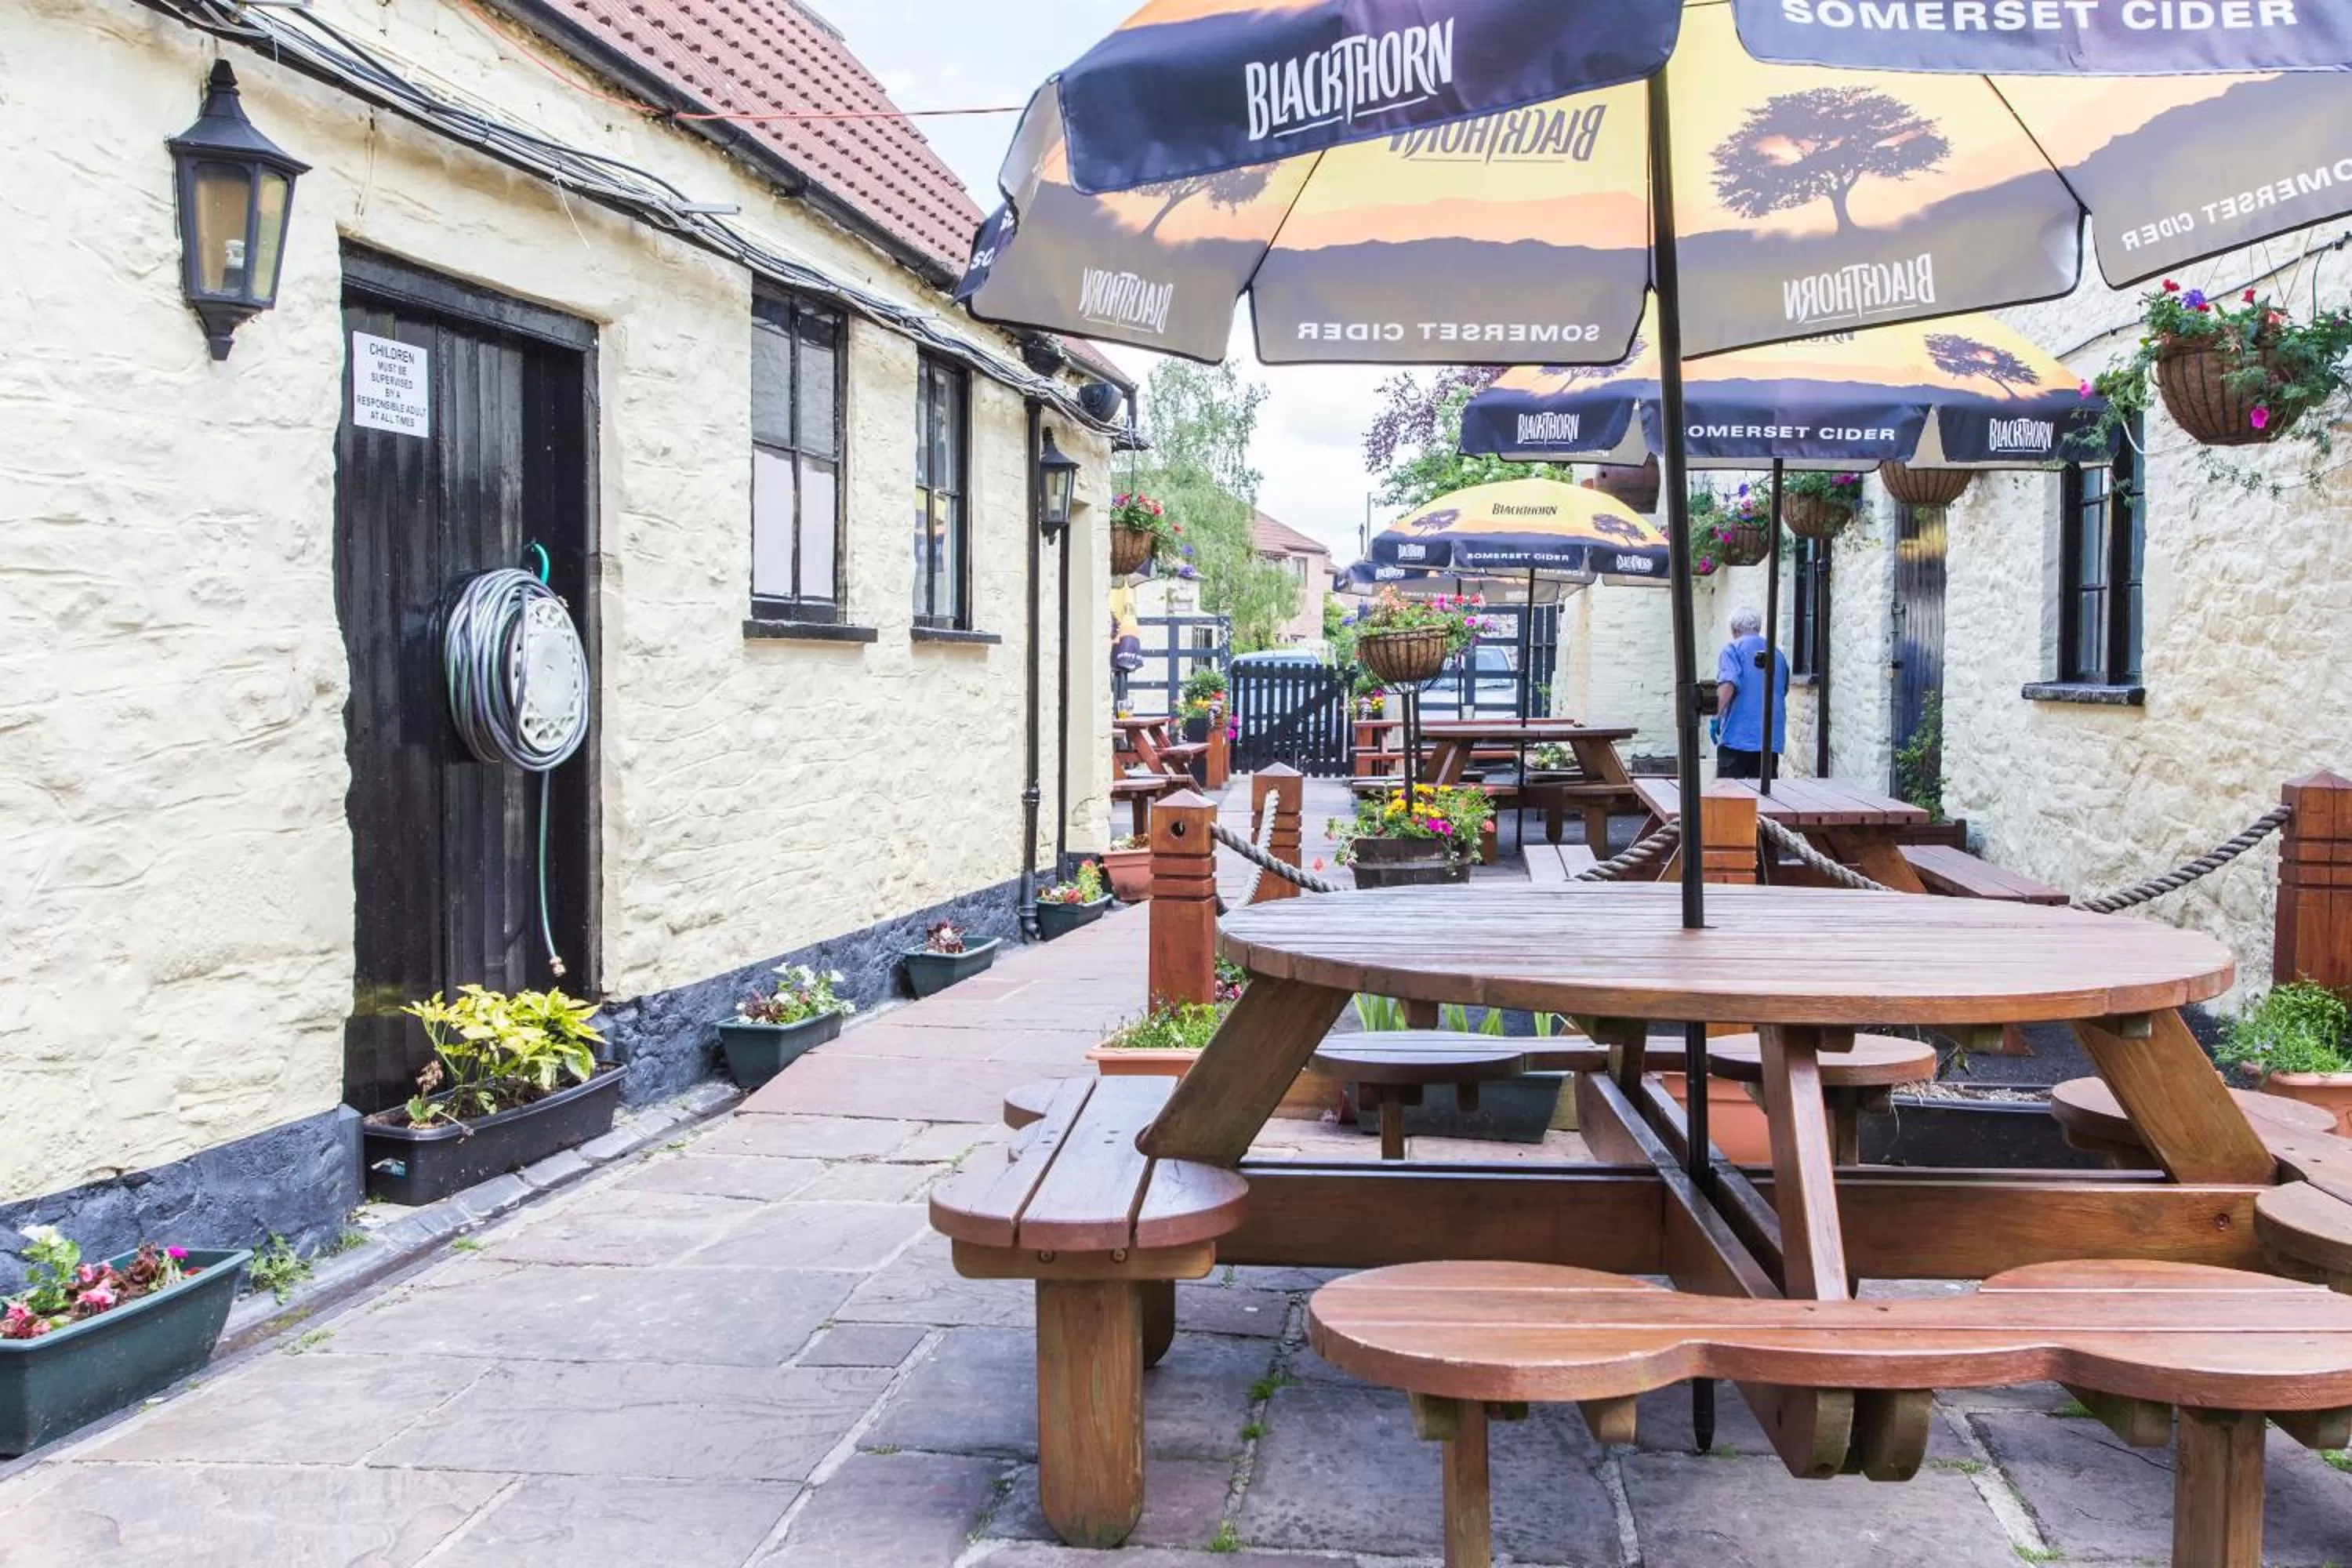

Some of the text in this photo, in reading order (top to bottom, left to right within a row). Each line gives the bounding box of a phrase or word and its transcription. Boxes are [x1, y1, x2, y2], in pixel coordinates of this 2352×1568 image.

[1782, 0, 2298, 31] SOMERSET CIDER
[1245, 16, 1454, 141] BLACKTHORN
[369, 343, 415, 365] CHILDREN
[378, 361, 407, 375] MUST BE
[371, 372, 413, 390] SUPERVISED
[386, 388, 394, 397] BY
[357, 394, 426, 417] RESPONSIBLE ADULT
[371, 411, 415, 427] AT ALL TIMES
[1517, 412, 1580, 445] BLACKTHORN
[1684, 425, 1895, 441] OMERSET CIDER
[1989, 418, 2054, 452] BLACKTHORN
